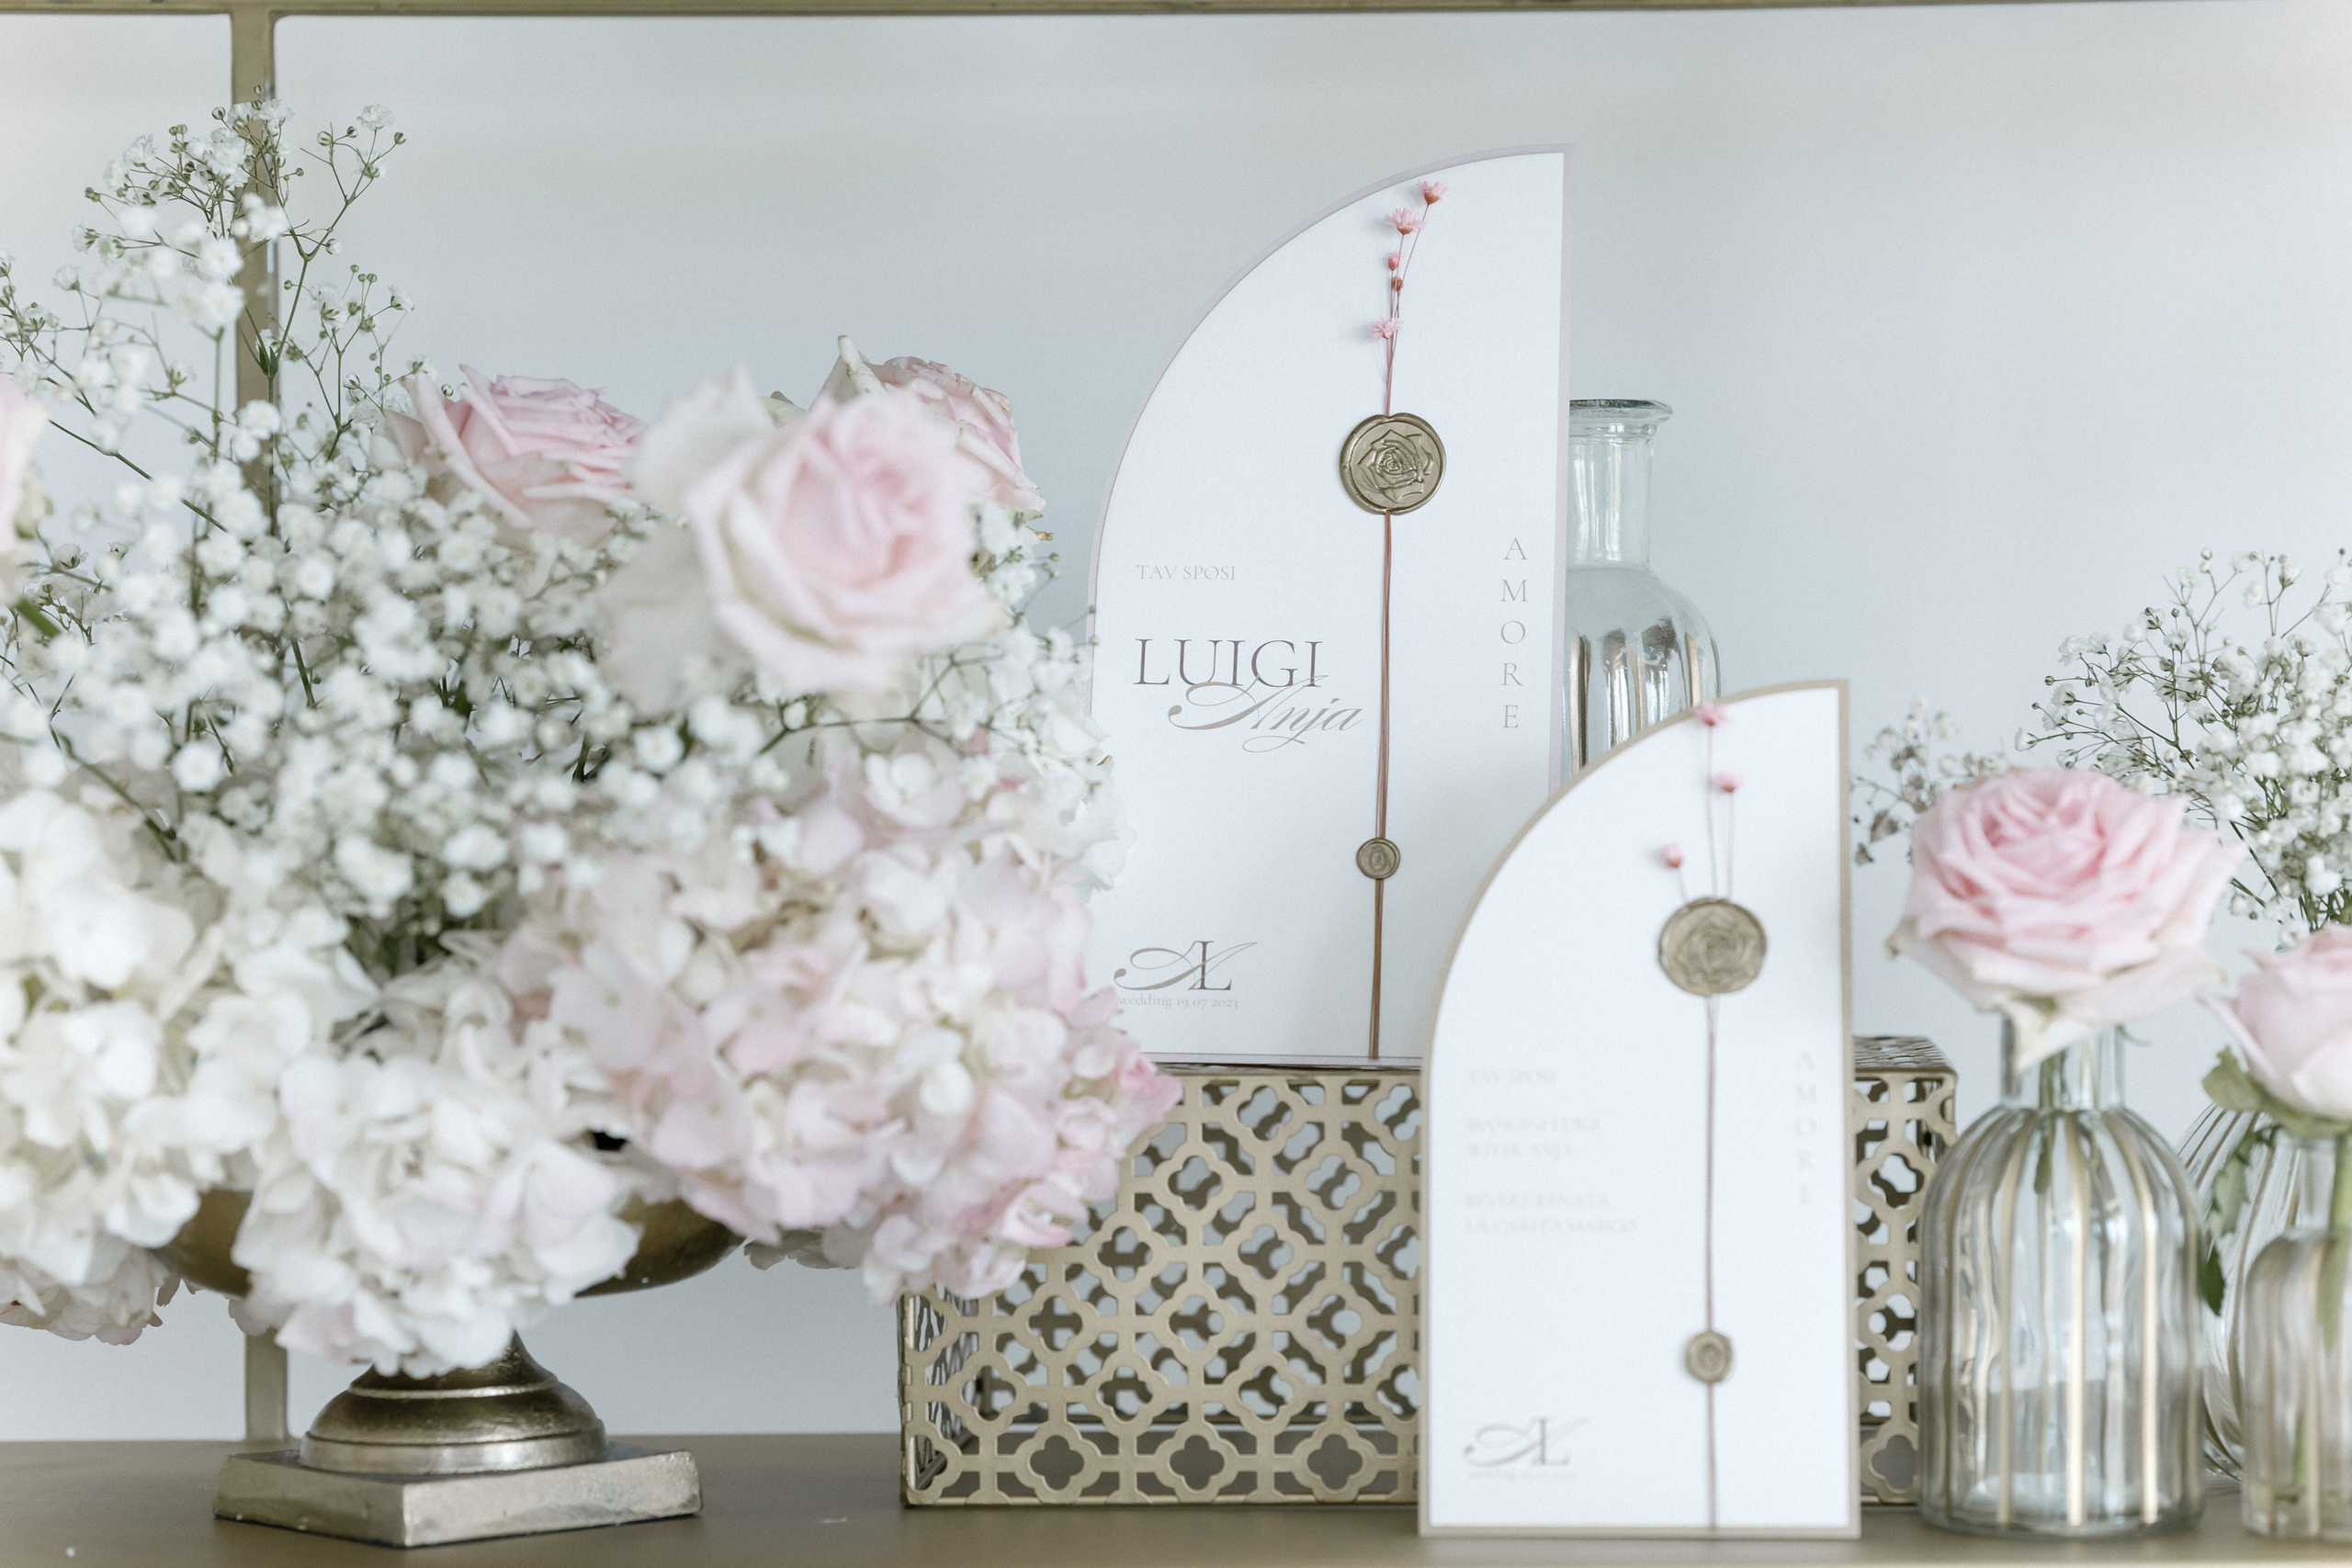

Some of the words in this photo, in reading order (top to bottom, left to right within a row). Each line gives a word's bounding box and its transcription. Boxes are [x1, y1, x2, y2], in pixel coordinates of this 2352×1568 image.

[1136, 564, 1178, 581] TAV
[1182, 565, 1237, 581] SPOSI
[1499, 536, 1529, 728] AMORE
[1133, 637, 1324, 688] LUIGI
[1168, 674, 1363, 753] Anja
[1118, 993, 1173, 1010] wedding
